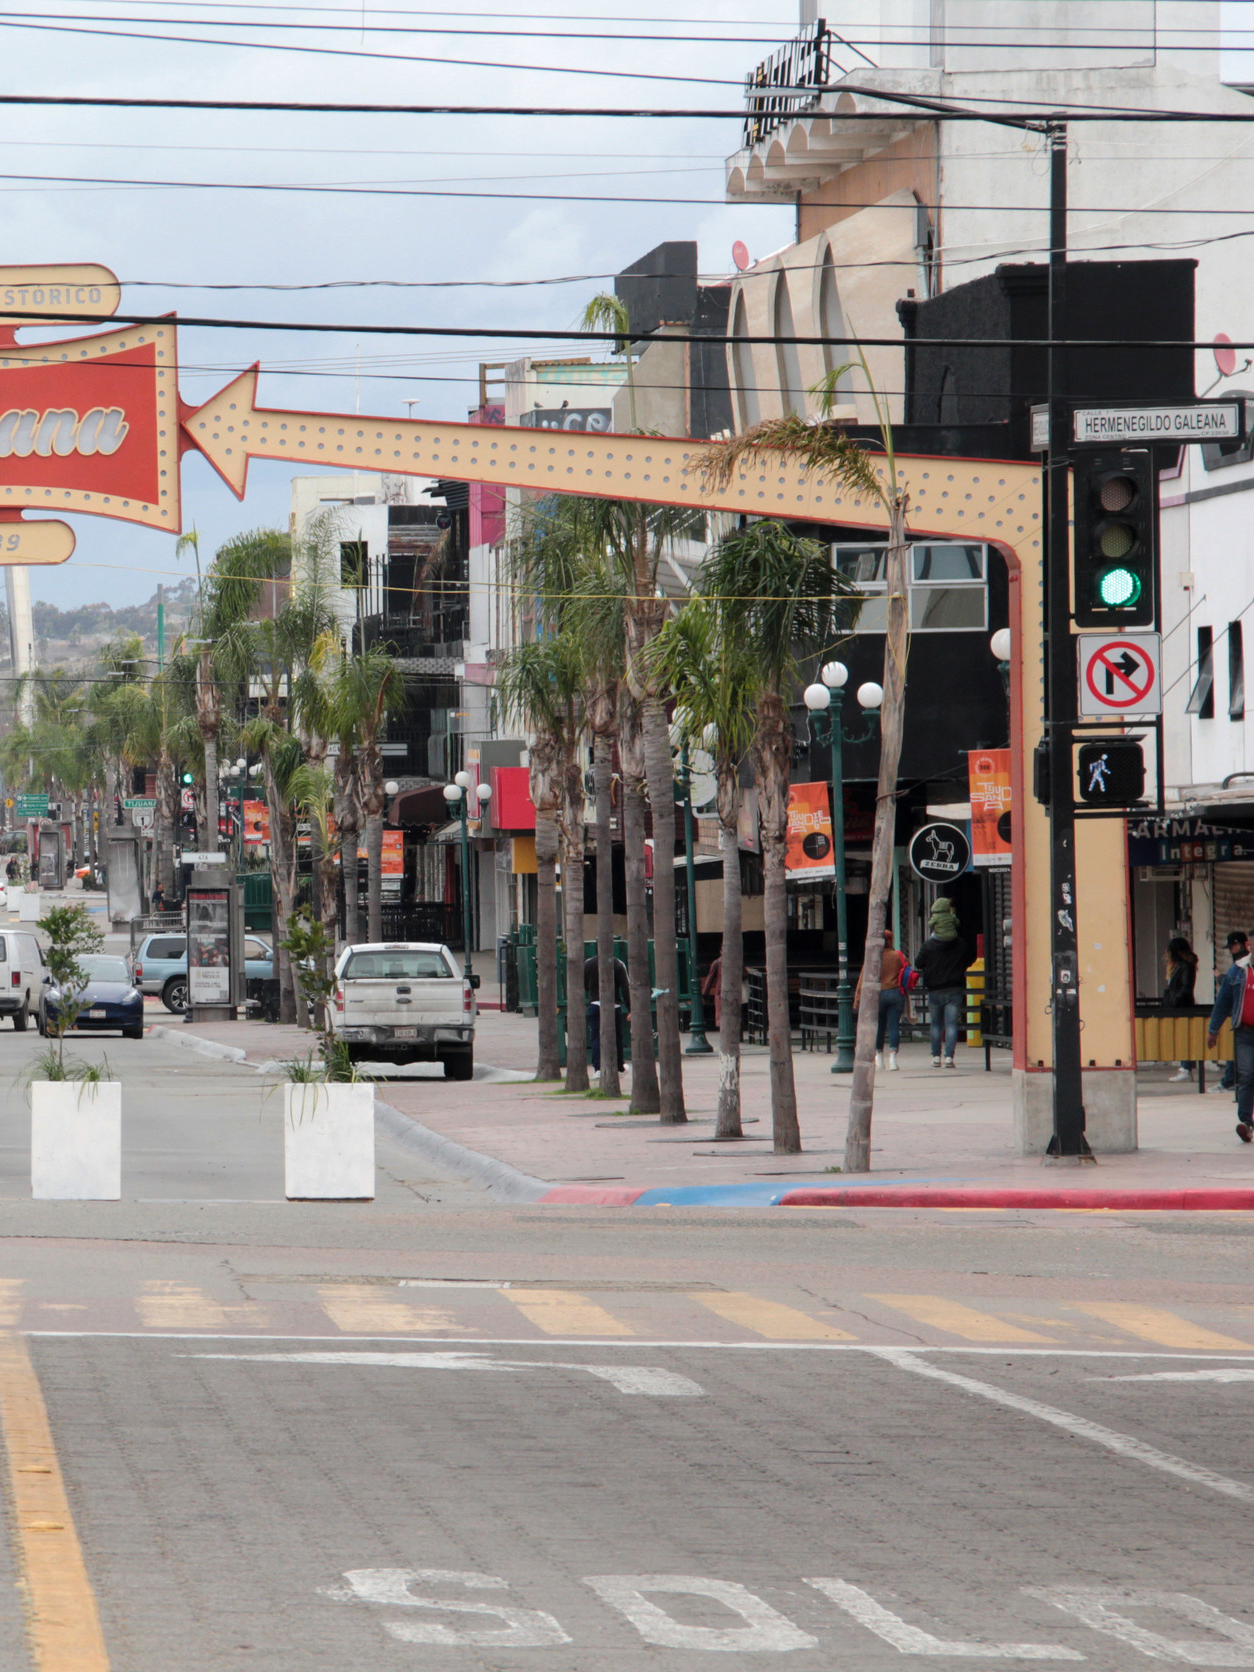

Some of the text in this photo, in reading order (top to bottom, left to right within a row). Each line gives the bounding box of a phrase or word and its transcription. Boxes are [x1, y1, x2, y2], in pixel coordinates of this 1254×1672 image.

[1085, 413, 1227, 433] HERMENEGILDO GALEANA
[1128, 819, 1242, 838] FARMAC
[924, 861, 956, 871] ZEBRA
